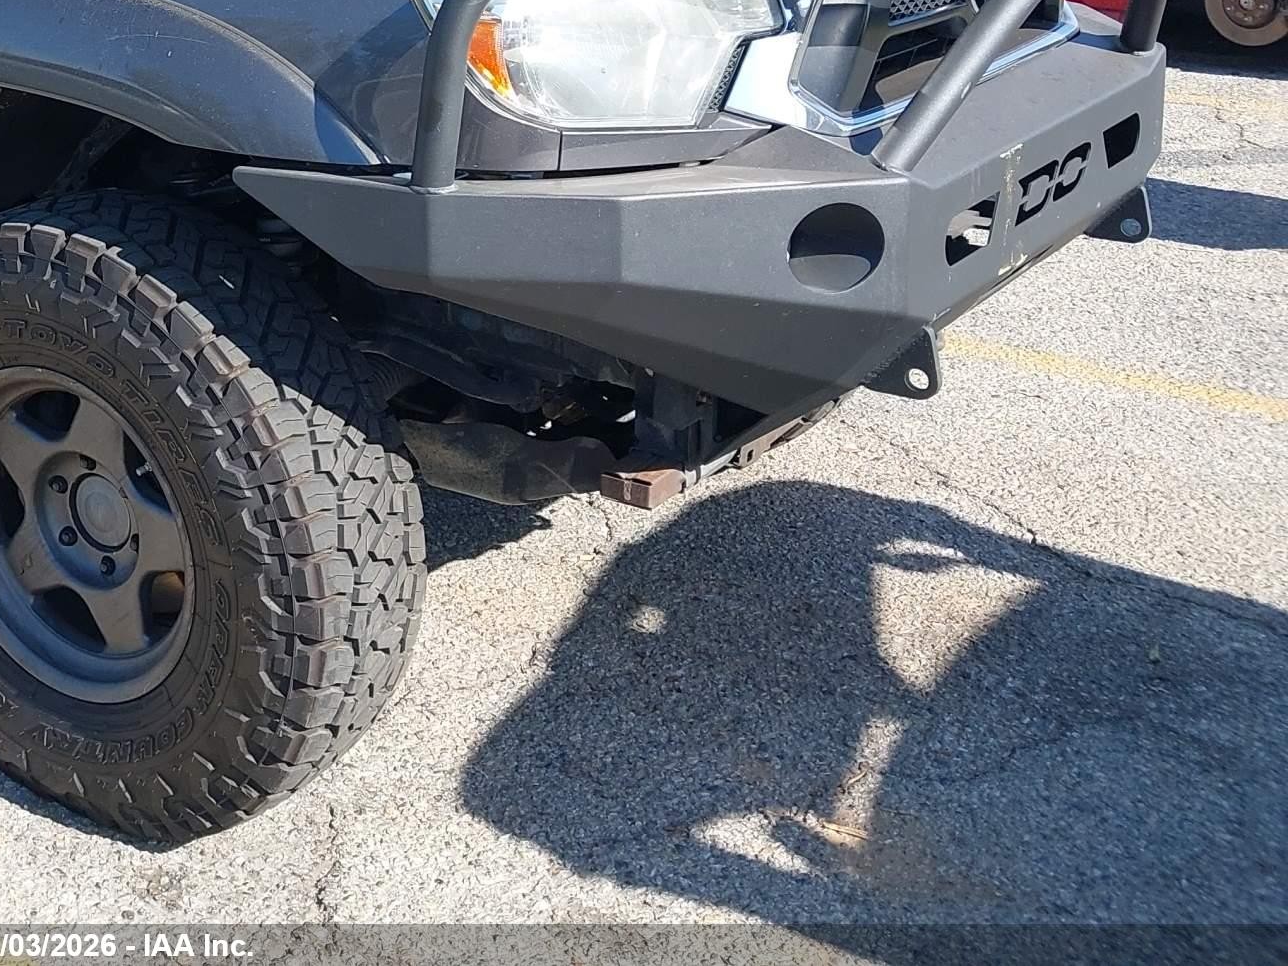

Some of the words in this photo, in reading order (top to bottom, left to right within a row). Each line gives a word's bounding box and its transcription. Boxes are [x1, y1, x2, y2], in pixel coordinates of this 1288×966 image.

[2, 317, 115, 378] TOYO
[120, 379, 221, 546] TIRES
[192, 578, 231, 715] OPEN
